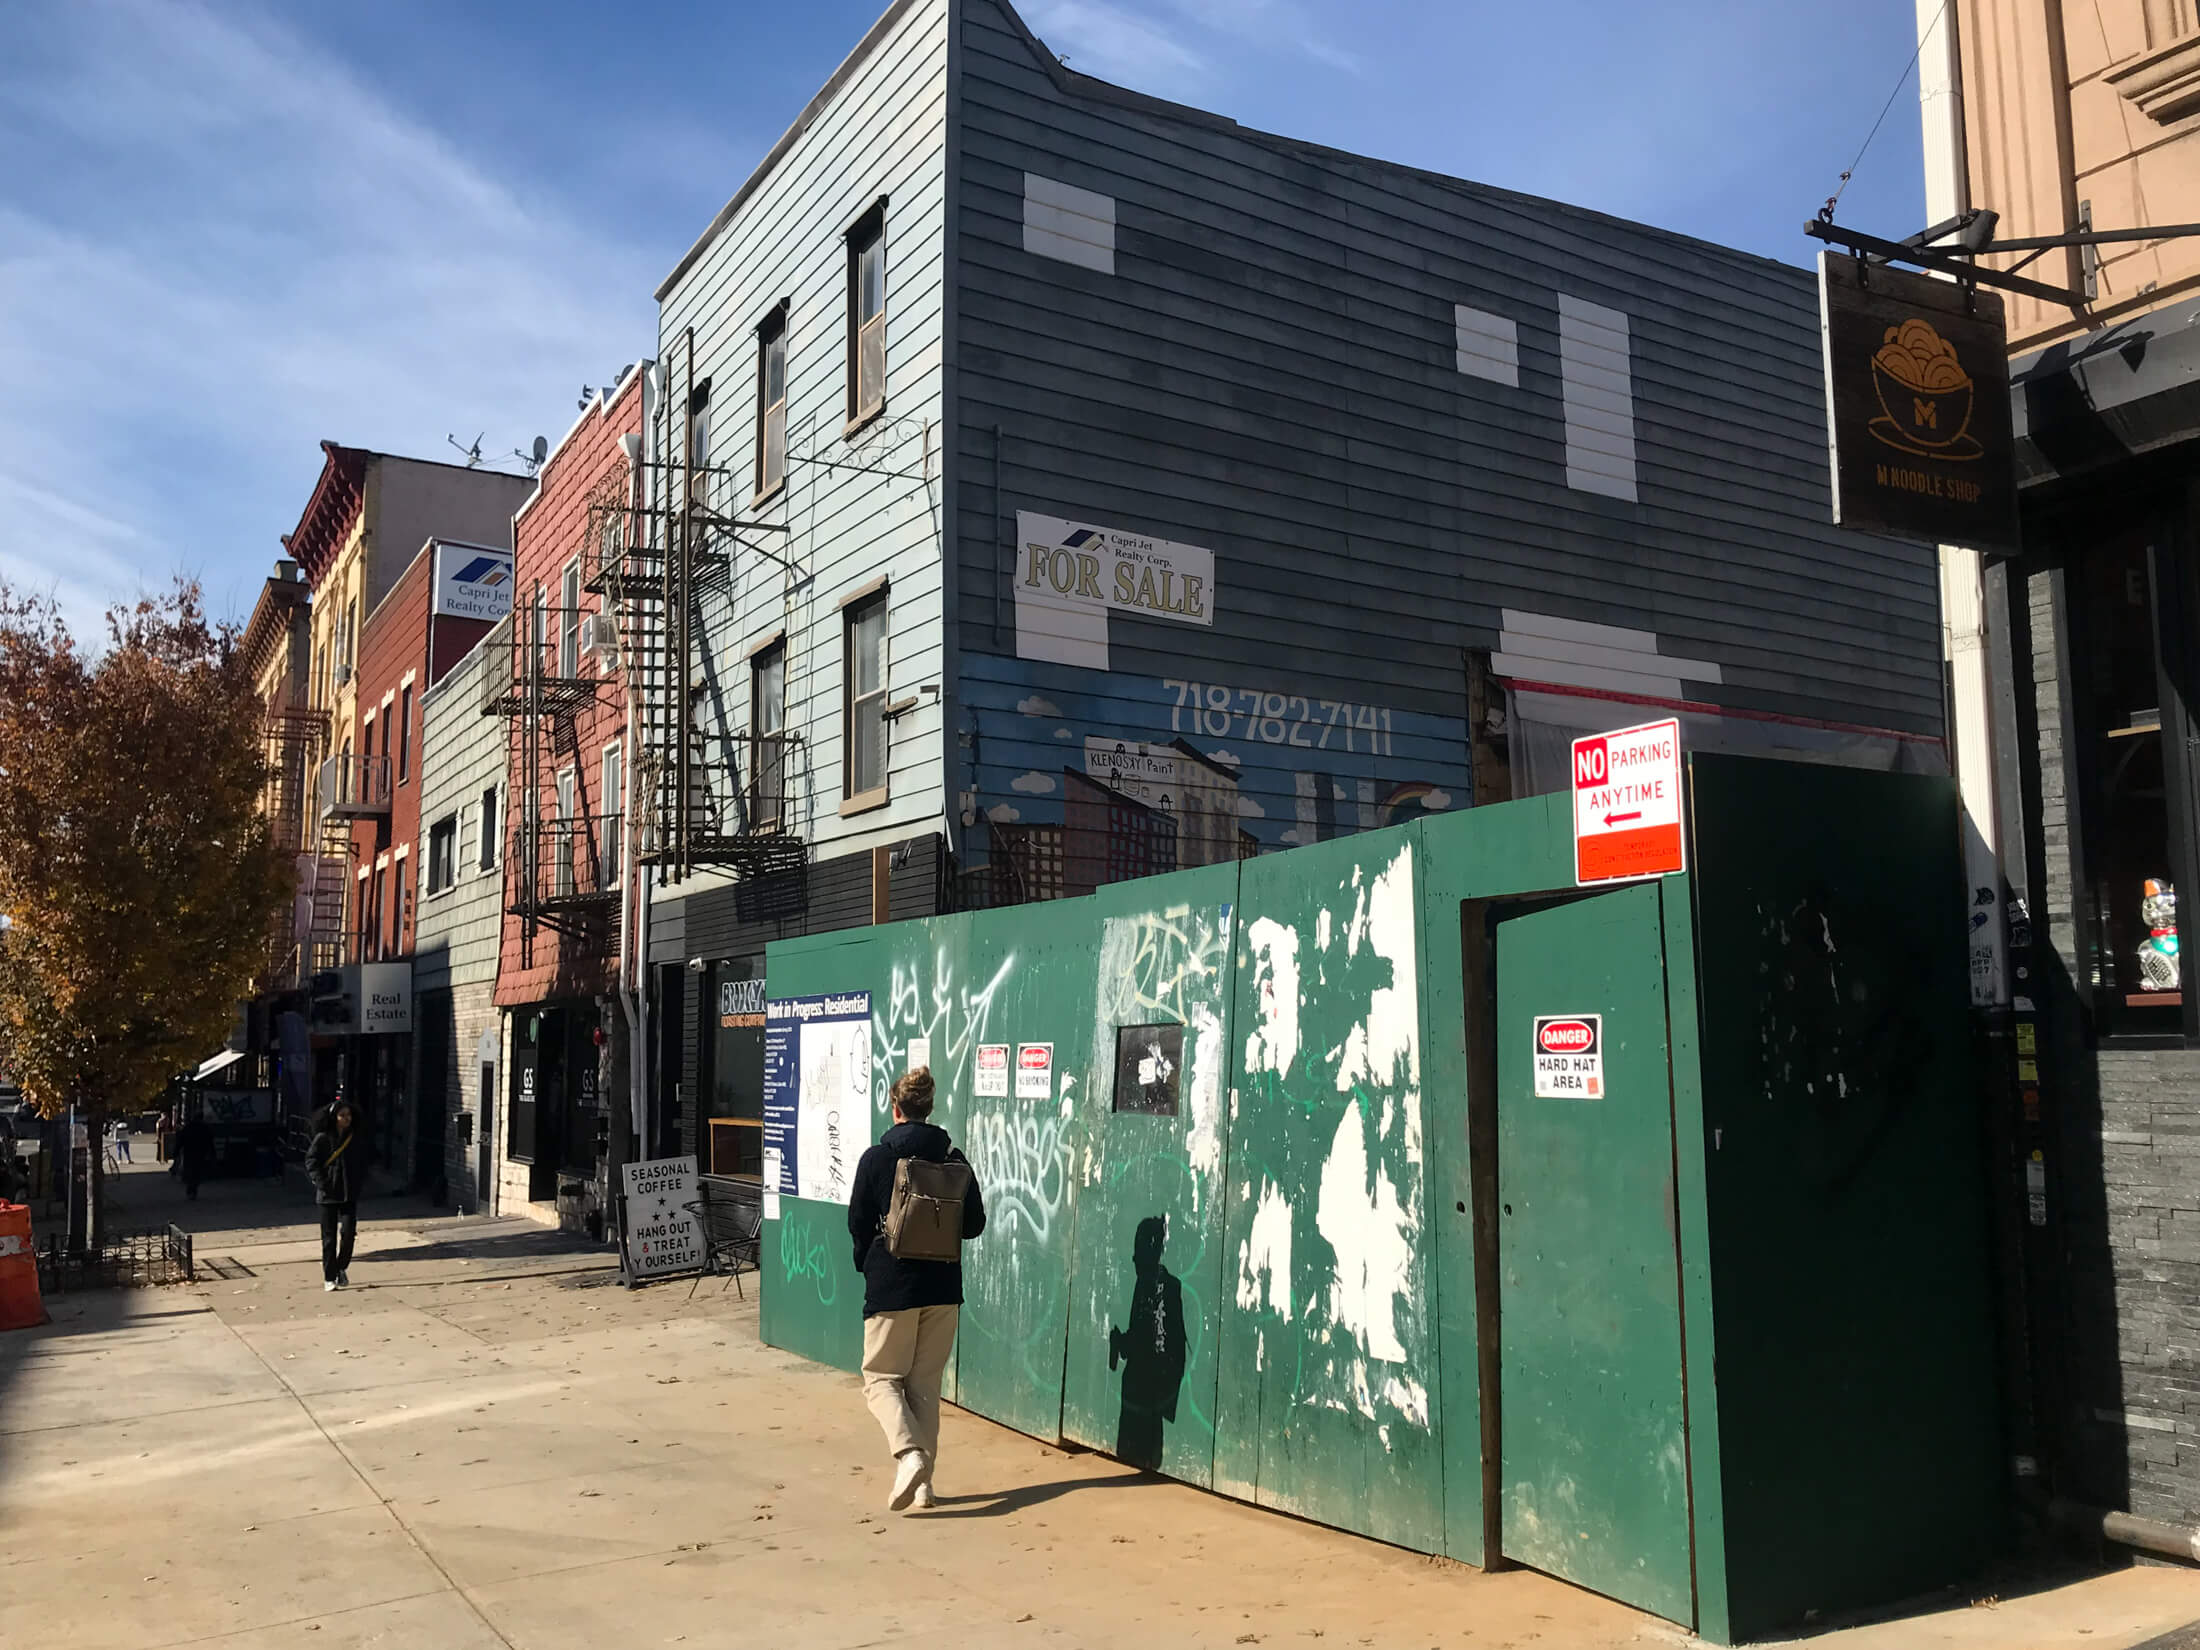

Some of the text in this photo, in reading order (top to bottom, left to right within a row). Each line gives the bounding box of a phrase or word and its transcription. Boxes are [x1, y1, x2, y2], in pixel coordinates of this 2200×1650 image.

[1913, 397, 1937, 429] M
[1876, 463, 1982, 503] M NOODLE SHOP
[1111, 534, 1153, 551] Capri Jet
[1115, 549, 1173, 569] Realty Corp.
[1025, 543, 1204, 618] FOR SALE
[458, 585, 509, 602] Capri Jet
[447, 598, 511, 616] Realty Cor
[1163, 679, 1392, 756] 718-782-7141
[1147, 759, 1174, 774] Paint
[1577, 740, 1671, 782] NO PARKING
[1590, 780, 1664, 810] ANYTIME
[372, 993, 401, 1005] Real
[767, 1002, 783, 1019] Work
[784, 1001, 792, 1018] in
[825, 993, 868, 1014] Residential
[366, 1008, 407, 1021] Estate
[1544, 1030, 1588, 1044] DANGER
[1021, 1053, 1047, 1063] DANGER
[1539, 1058, 1596, 1071] HARD HAT
[523, 1068, 534, 1089] GS
[1553, 1075, 1582, 1089] AREA
[632, 1164, 690, 1181] SEASONAL
[638, 1179, 682, 1194] COFFEE
[637, 1221, 691, 1240] HANG OUT
[654, 1236, 690, 1252] TREAT
